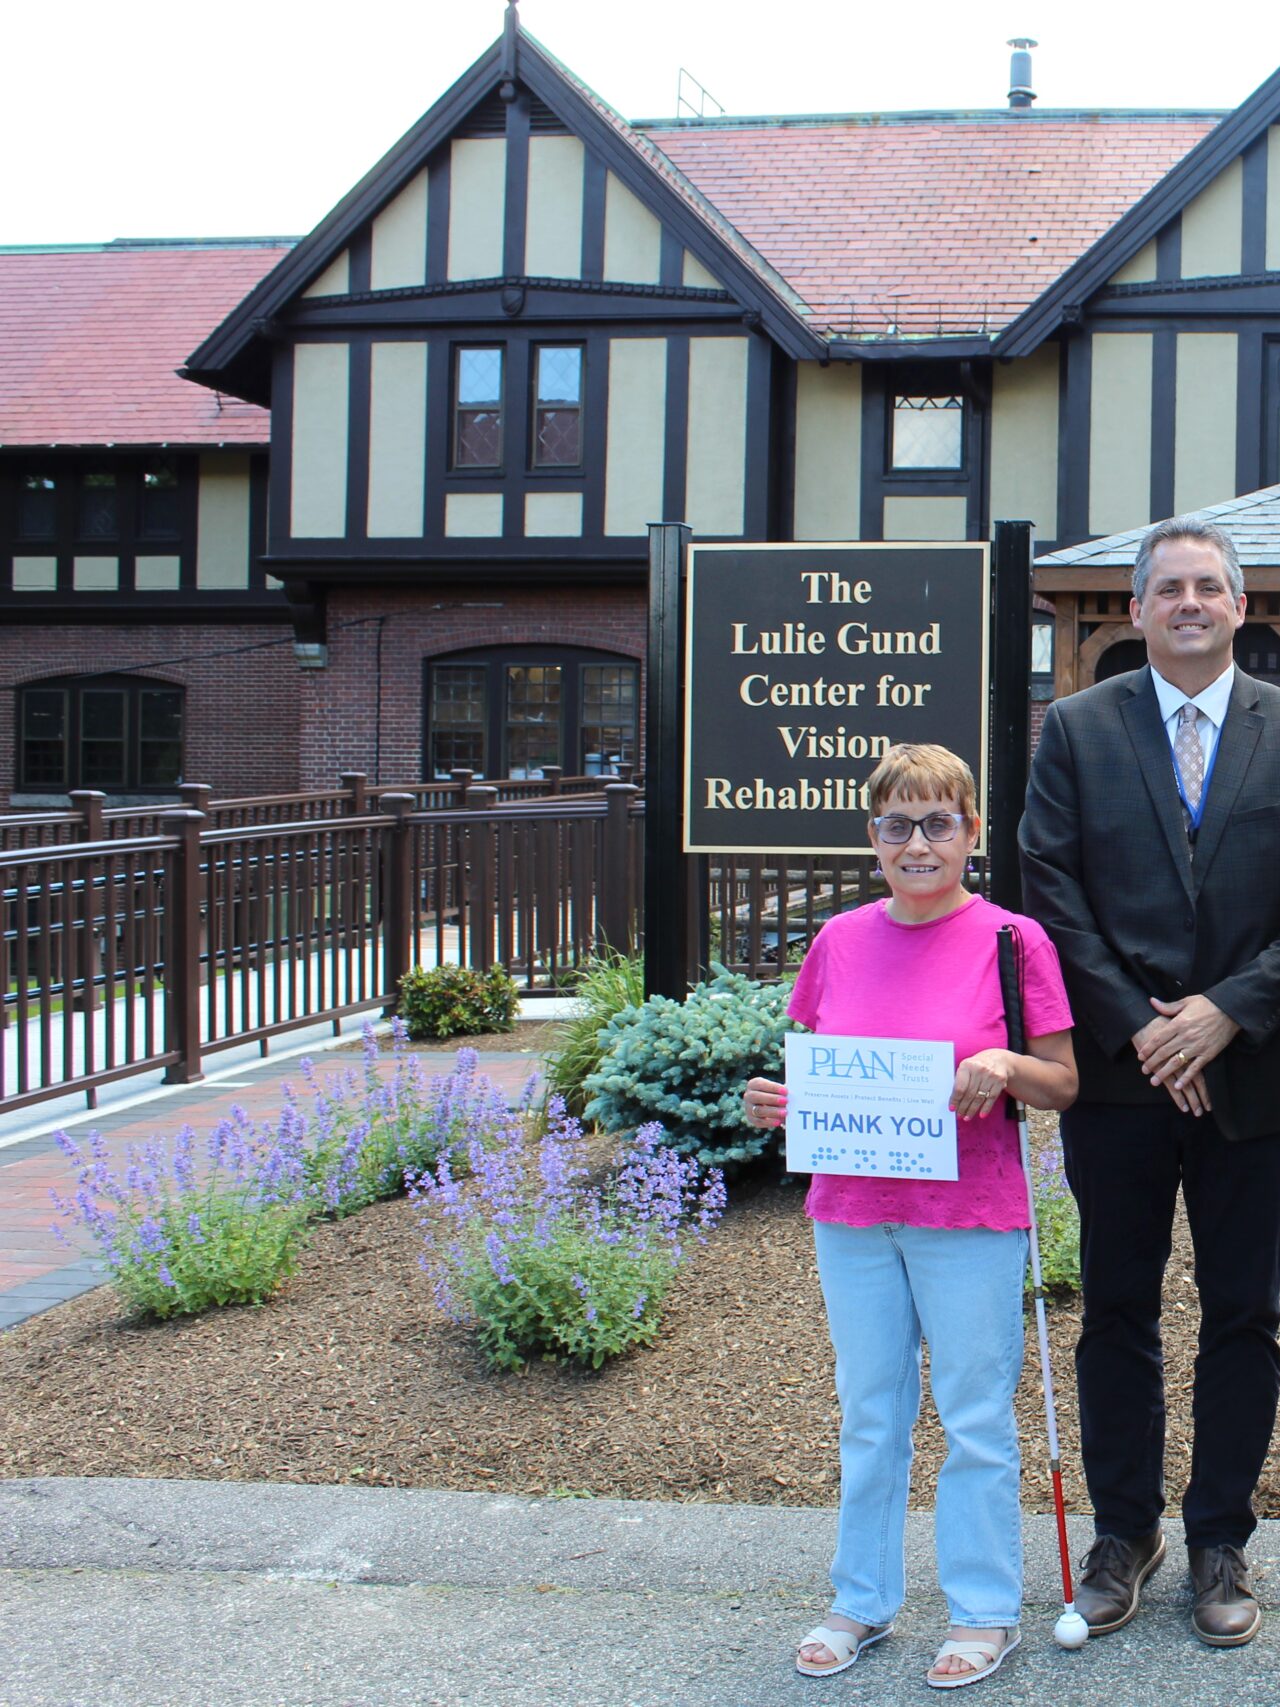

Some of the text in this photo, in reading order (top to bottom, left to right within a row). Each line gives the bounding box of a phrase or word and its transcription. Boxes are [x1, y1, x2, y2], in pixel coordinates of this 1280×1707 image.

[801, 572, 872, 604] The
[730, 622, 942, 654] Lulie Gund
[740, 674, 931, 707] Center for
[777, 726, 891, 758] Vision
[704, 778, 870, 811] Rehabilit
[808, 1047, 934, 1081] PLAN Special
[902, 1063, 930, 1072] Needs
[902, 1074, 929, 1083] Trusts
[798, 1110, 943, 1138] THANK YOU
